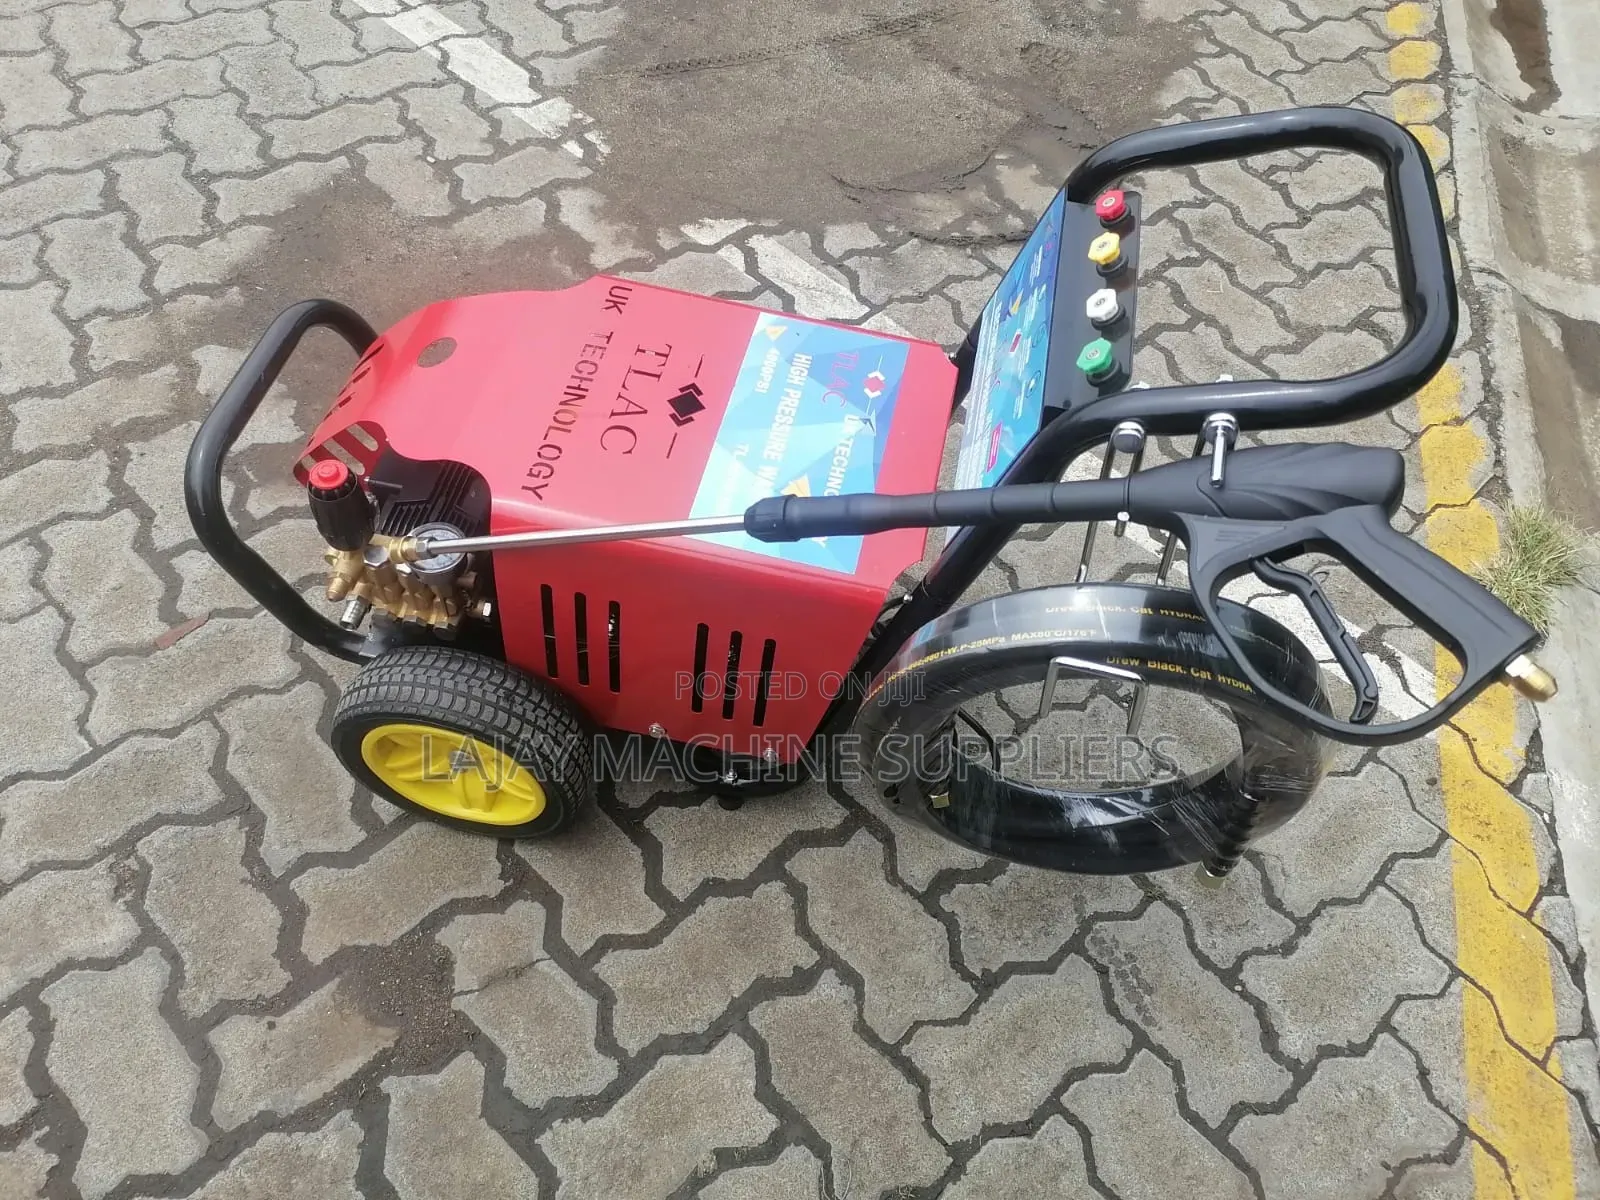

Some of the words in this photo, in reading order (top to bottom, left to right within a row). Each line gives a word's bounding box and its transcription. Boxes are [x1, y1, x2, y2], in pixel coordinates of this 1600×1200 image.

[601, 286, 633, 315] UK
[786, 352, 813, 386] HIGH
[821, 350, 860, 408] TLAC
[521, 331, 614, 500] TECHNOLOGY
[599, 343, 674, 456] TLAC
[763, 387, 803, 461] PRESSURE
[1106, 656, 1140, 667] Drew
[1190, 667, 1213, 681] Cat
